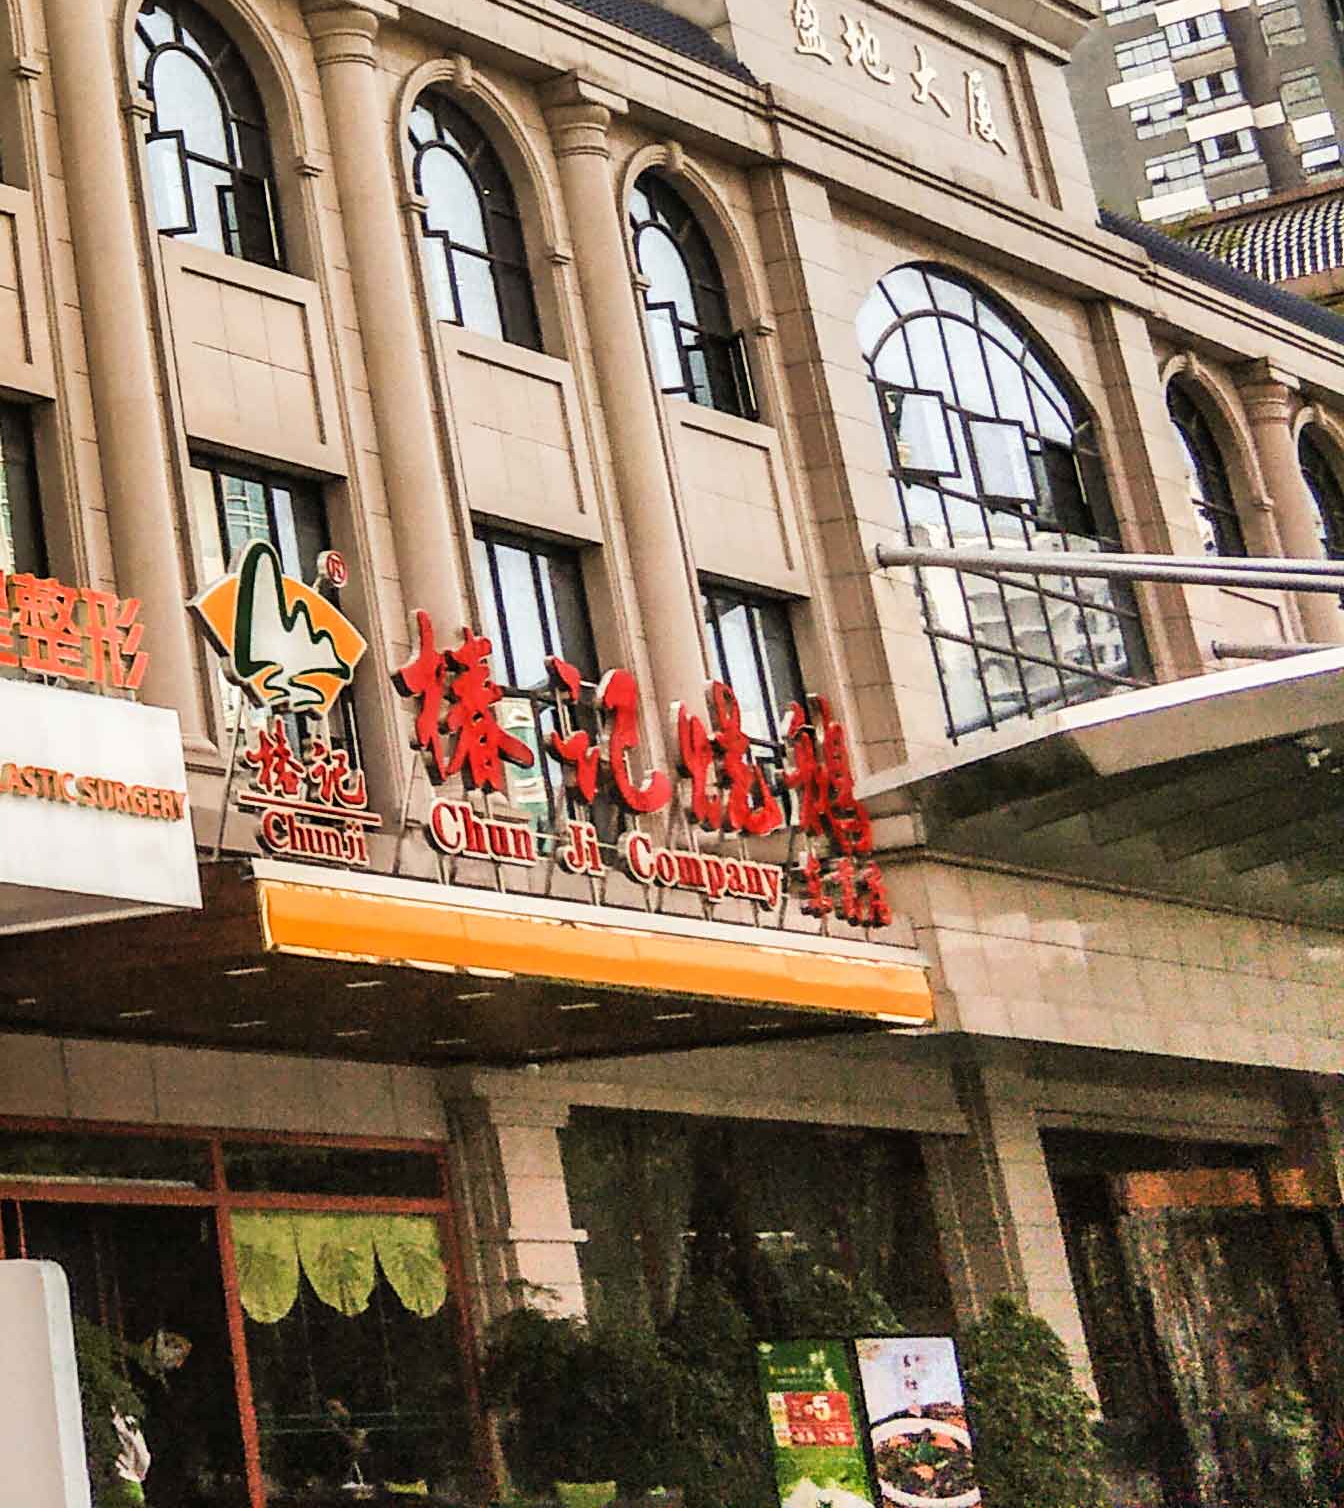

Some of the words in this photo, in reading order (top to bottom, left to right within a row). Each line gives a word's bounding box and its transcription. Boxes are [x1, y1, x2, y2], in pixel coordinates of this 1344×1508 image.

[78, 775, 188, 822] SURGERY
[262, 810, 368, 864] Chunji
[431, 796, 537, 867] Chun
[562, 822, 606, 876] Ji
[626, 829, 784, 910] Company
